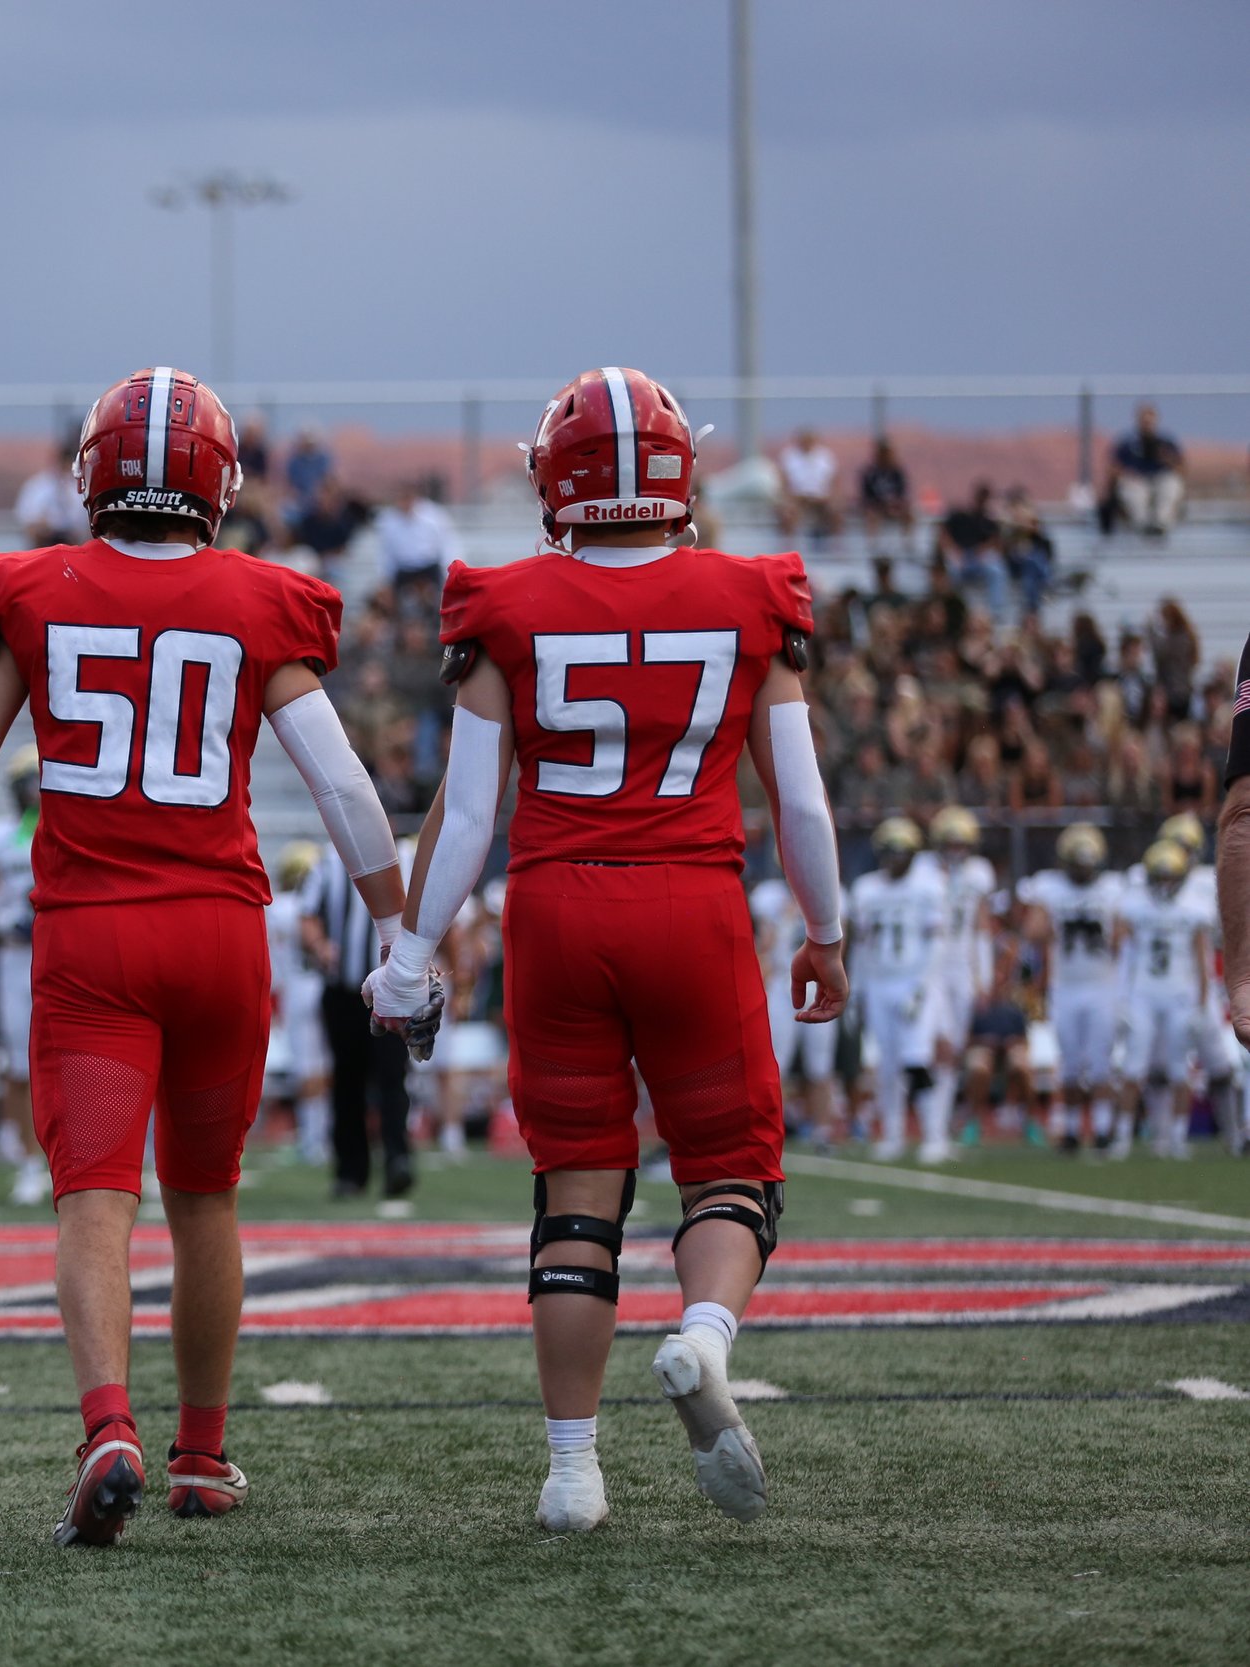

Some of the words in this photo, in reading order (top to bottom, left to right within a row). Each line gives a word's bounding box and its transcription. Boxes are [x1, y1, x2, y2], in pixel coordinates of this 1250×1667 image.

[125, 488, 183, 505] schutt
[583, 502, 665, 522] Riddell
[39, 622, 246, 807] 50
[530, 628, 741, 799] 57
